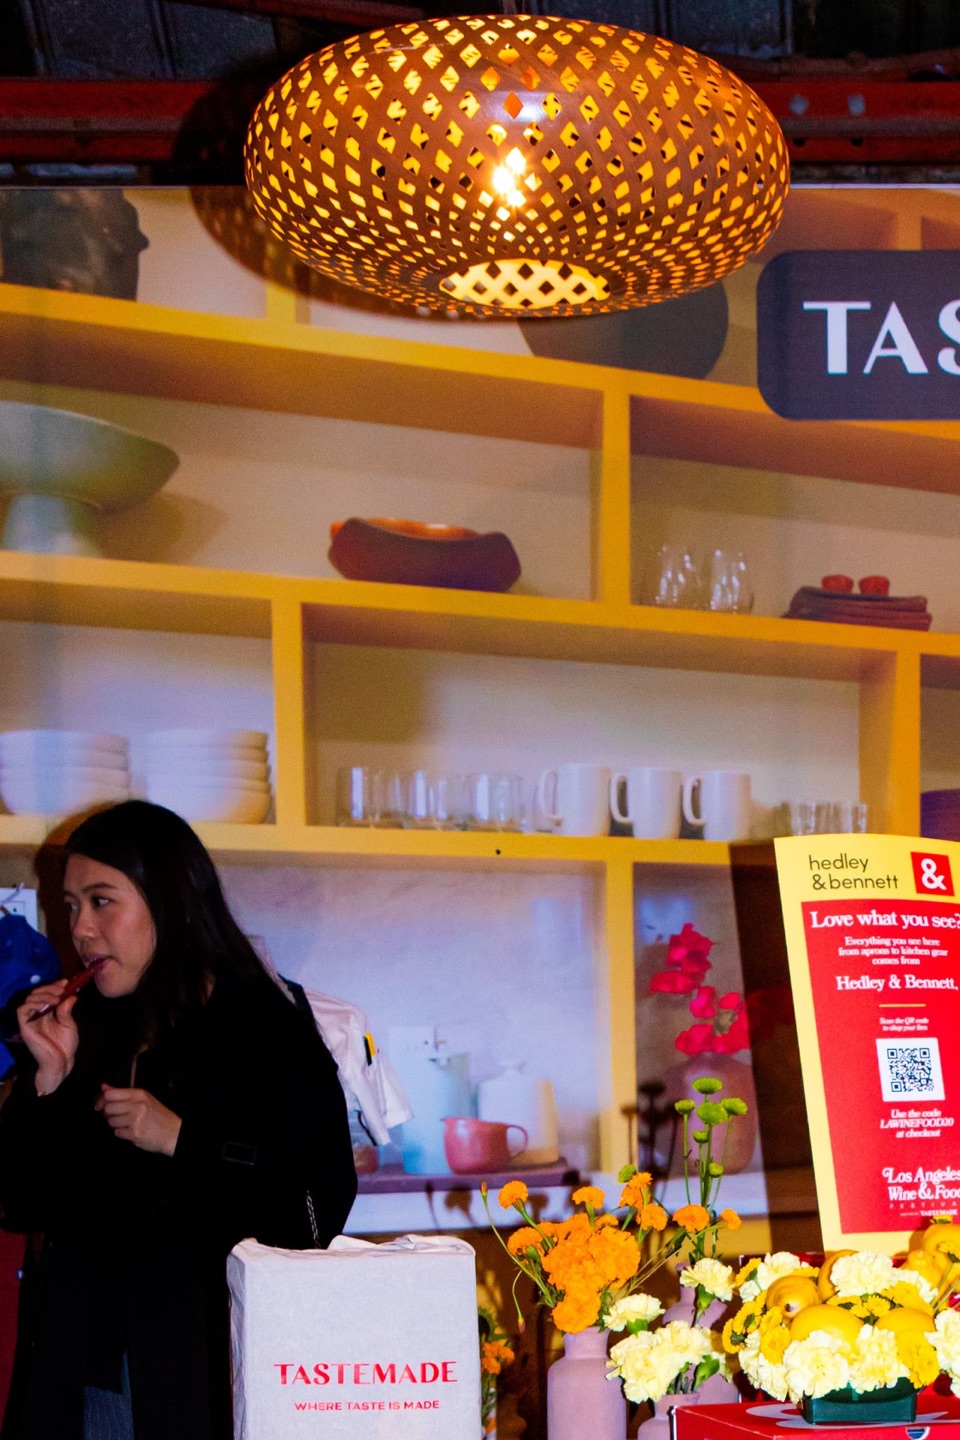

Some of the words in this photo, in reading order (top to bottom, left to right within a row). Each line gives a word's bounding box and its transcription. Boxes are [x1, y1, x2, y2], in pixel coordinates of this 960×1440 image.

[808, 853, 869, 873] hedley
[921, 858, 947, 891] &
[810, 911, 854, 928] Love
[857, 909, 898, 926] what
[901, 913, 929, 929] you
[845, 936, 891, 947] Everything
[892, 938, 907, 947] you
[908, 938, 921, 946] see
[923, 937, 940, 946] here
[838, 947, 859, 956] from
[861, 948, 889, 957] aprons
[891, 947, 900, 955] to
[901, 946, 930, 956] kitchen
[931, 949, 948, 957] gear
[900, 956, 920, 965] from
[836, 975, 885, 991] Hedley
[888, 974, 901, 989] &
[891, 1109, 907, 1118] Use
[908, 1108, 921, 1118] the
[922, 1108, 941, 1117] code
[905, 1129, 941, 1137] checkout
[882, 1167, 913, 1184] Los
[887, 1185, 917, 1201] Wine
[917, 1181, 935, 1200] &
[273, 1361, 458, 1386] TASTEMADE
[294, 1402, 342, 1411] WHERE
[345, 1401, 385, 1411] TASTE
[388, 1401, 400, 1410] IS
[403, 1400, 440, 1410] MADE
